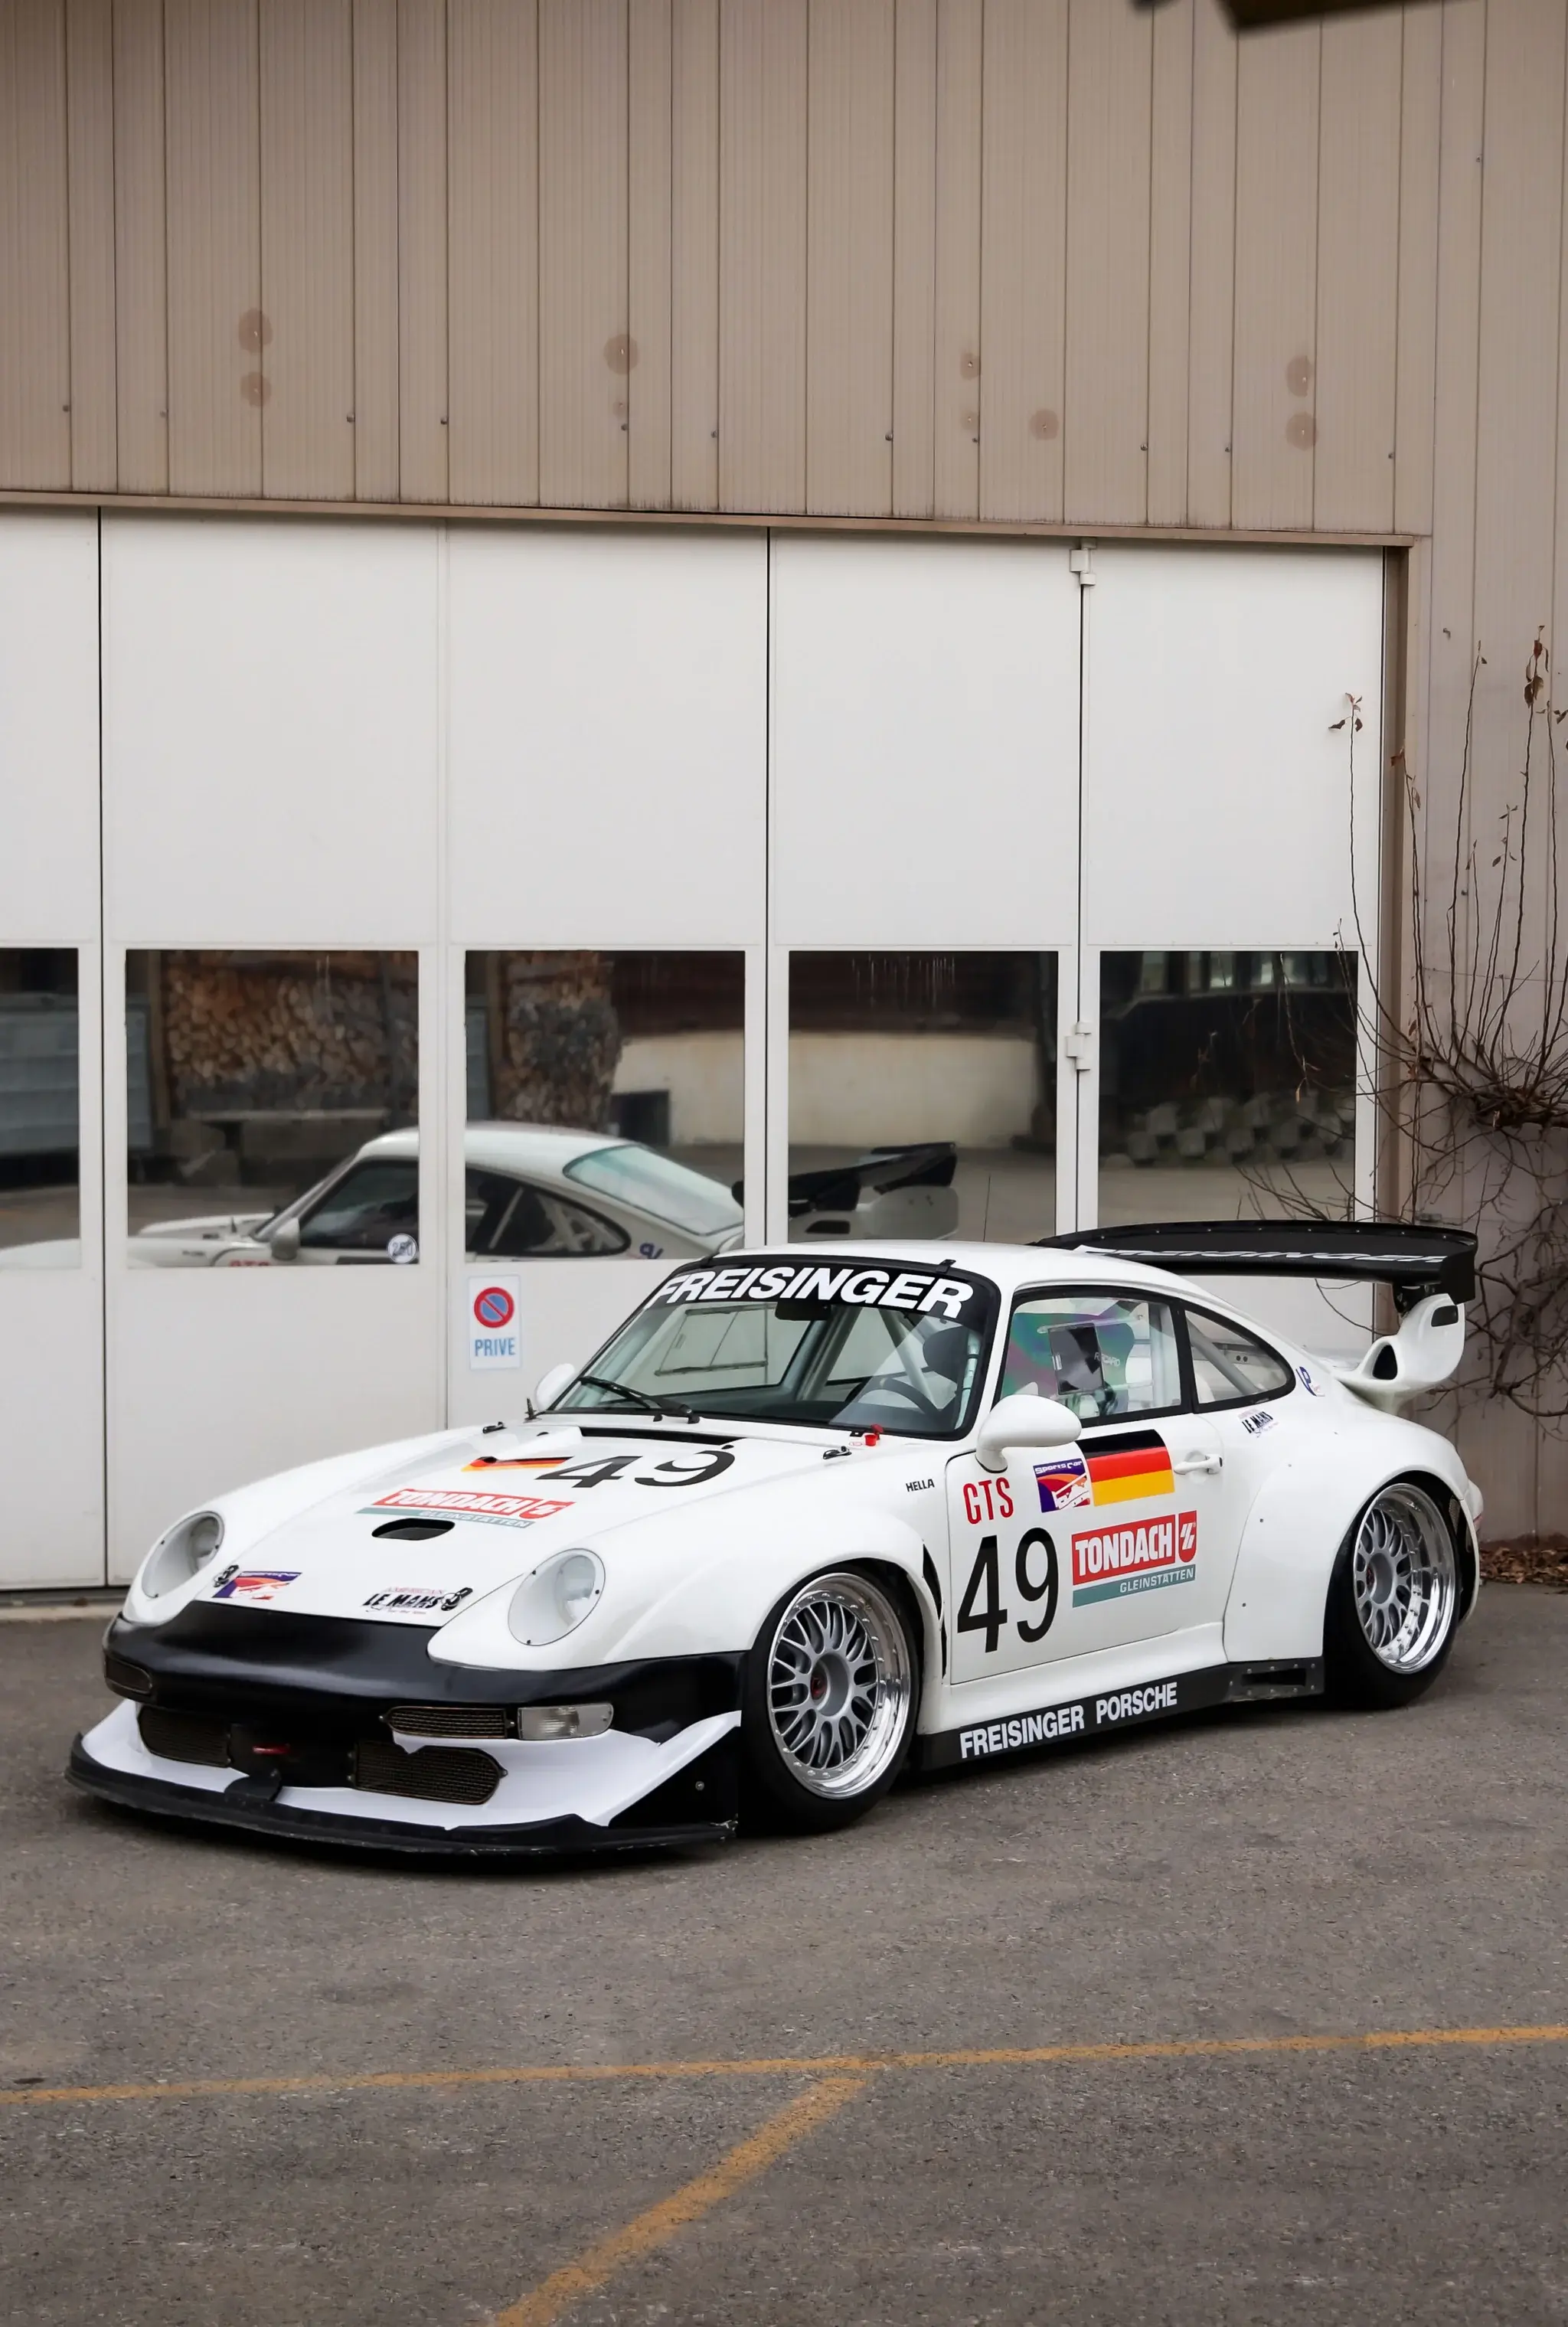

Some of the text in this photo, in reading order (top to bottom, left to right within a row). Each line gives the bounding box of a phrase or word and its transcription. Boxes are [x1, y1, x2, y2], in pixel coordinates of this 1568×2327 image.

[648, 1266, 974, 1319] FREISINGER
[534, 1449, 736, 1488] 49
[905, 1478, 935, 1492] HELLA
[384, 1490, 533, 1513] TONDACH
[962, 1476, 1014, 1525] GTS
[1075, 1522, 1173, 1577] TONDACH
[956, 1527, 1060, 1654] 49
[959, 1682, 1178, 1759] FREISINGER PORSCHE
